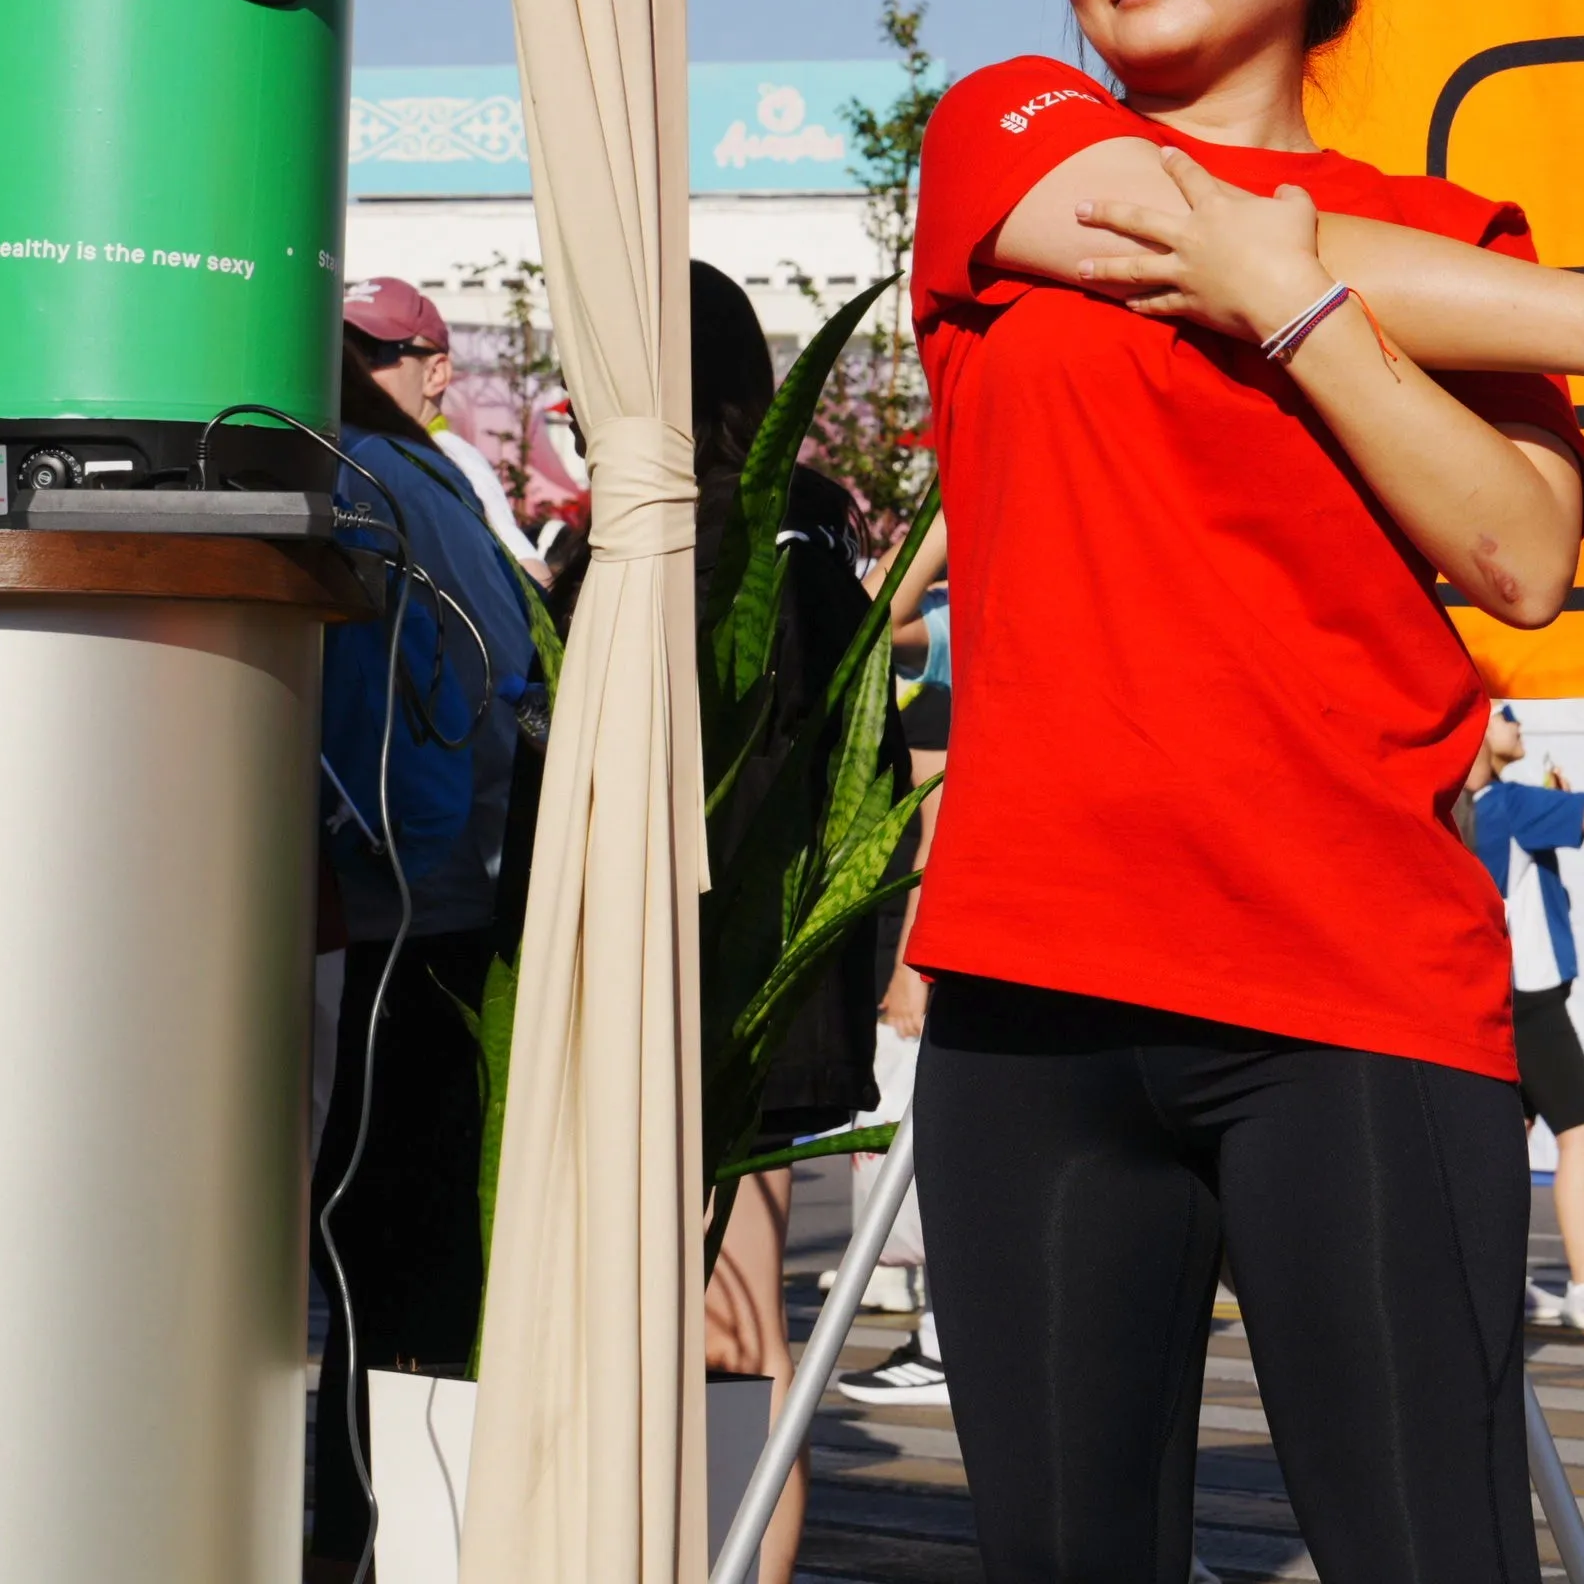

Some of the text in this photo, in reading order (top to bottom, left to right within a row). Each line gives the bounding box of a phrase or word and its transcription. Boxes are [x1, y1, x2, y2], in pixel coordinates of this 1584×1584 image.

[76, 239, 97, 262] is
[103, 242, 145, 265] the
[152, 250, 200, 270] new
[206, 256, 255, 281] sexy
